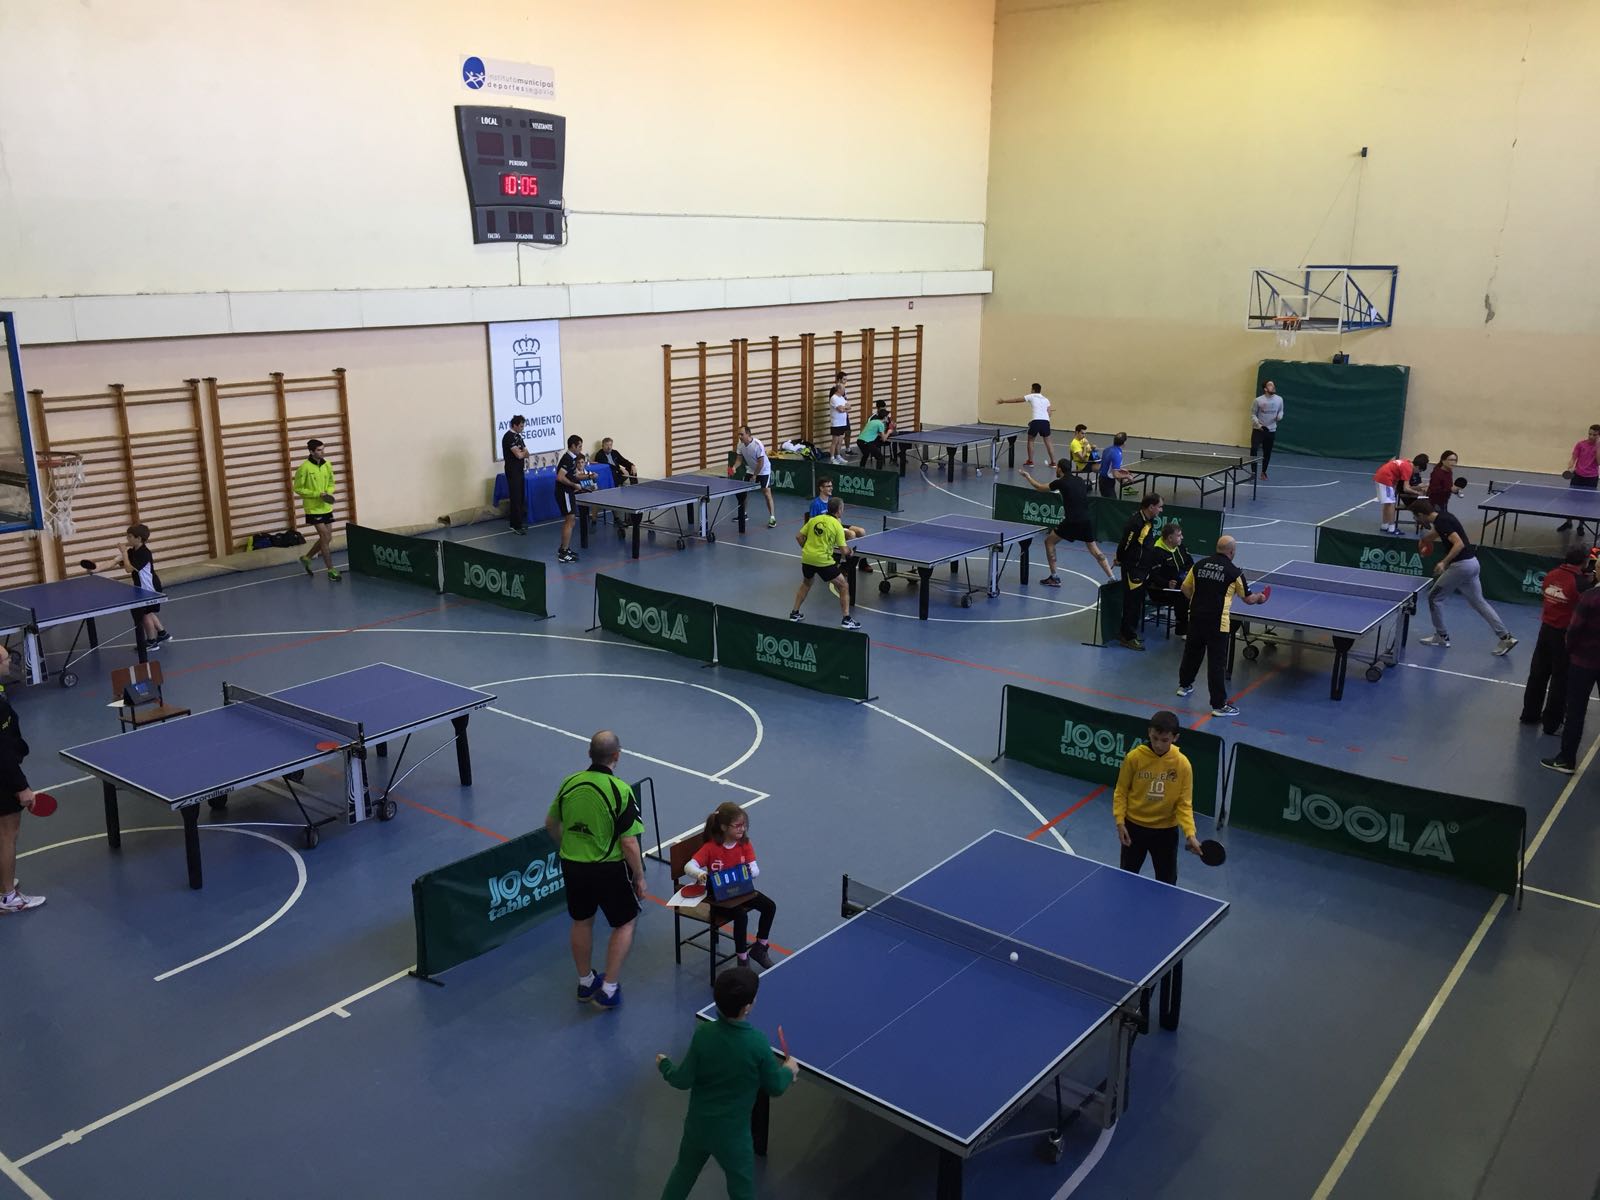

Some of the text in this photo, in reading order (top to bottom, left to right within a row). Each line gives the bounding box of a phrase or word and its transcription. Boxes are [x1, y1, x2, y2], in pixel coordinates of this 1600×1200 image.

[481, 117, 498, 126] LOCAL
[532, 122, 553, 131] VISITANTE
[505, 176, 537, 195] 10:05
[498, 414, 562, 431] AYAMIENTO
[521, 427, 556, 440] SEGOVIA
[839, 474, 875, 491] JOOLA
[373, 544, 411, 566] JOOLA
[1360, 547, 1424, 569] JOOLA
[1197, 568, 1225, 583] ESPAÑA
[1360, 561, 1424, 576] table tennis
[464, 561, 526, 601] JOOLA
[1522, 584, 1543, 595] tab
[617, 598, 688, 644] JOOLA
[756, 633, 817, 664] JOOLA
[756, 652, 817, 673] table tennis
[1060, 743, 1097, 762] table
[1149, 780, 1165, 793] 10
[1282, 784, 1455, 863] JOOLA
[488, 851, 563, 909] JOOL
[488, 893, 531, 922] table
